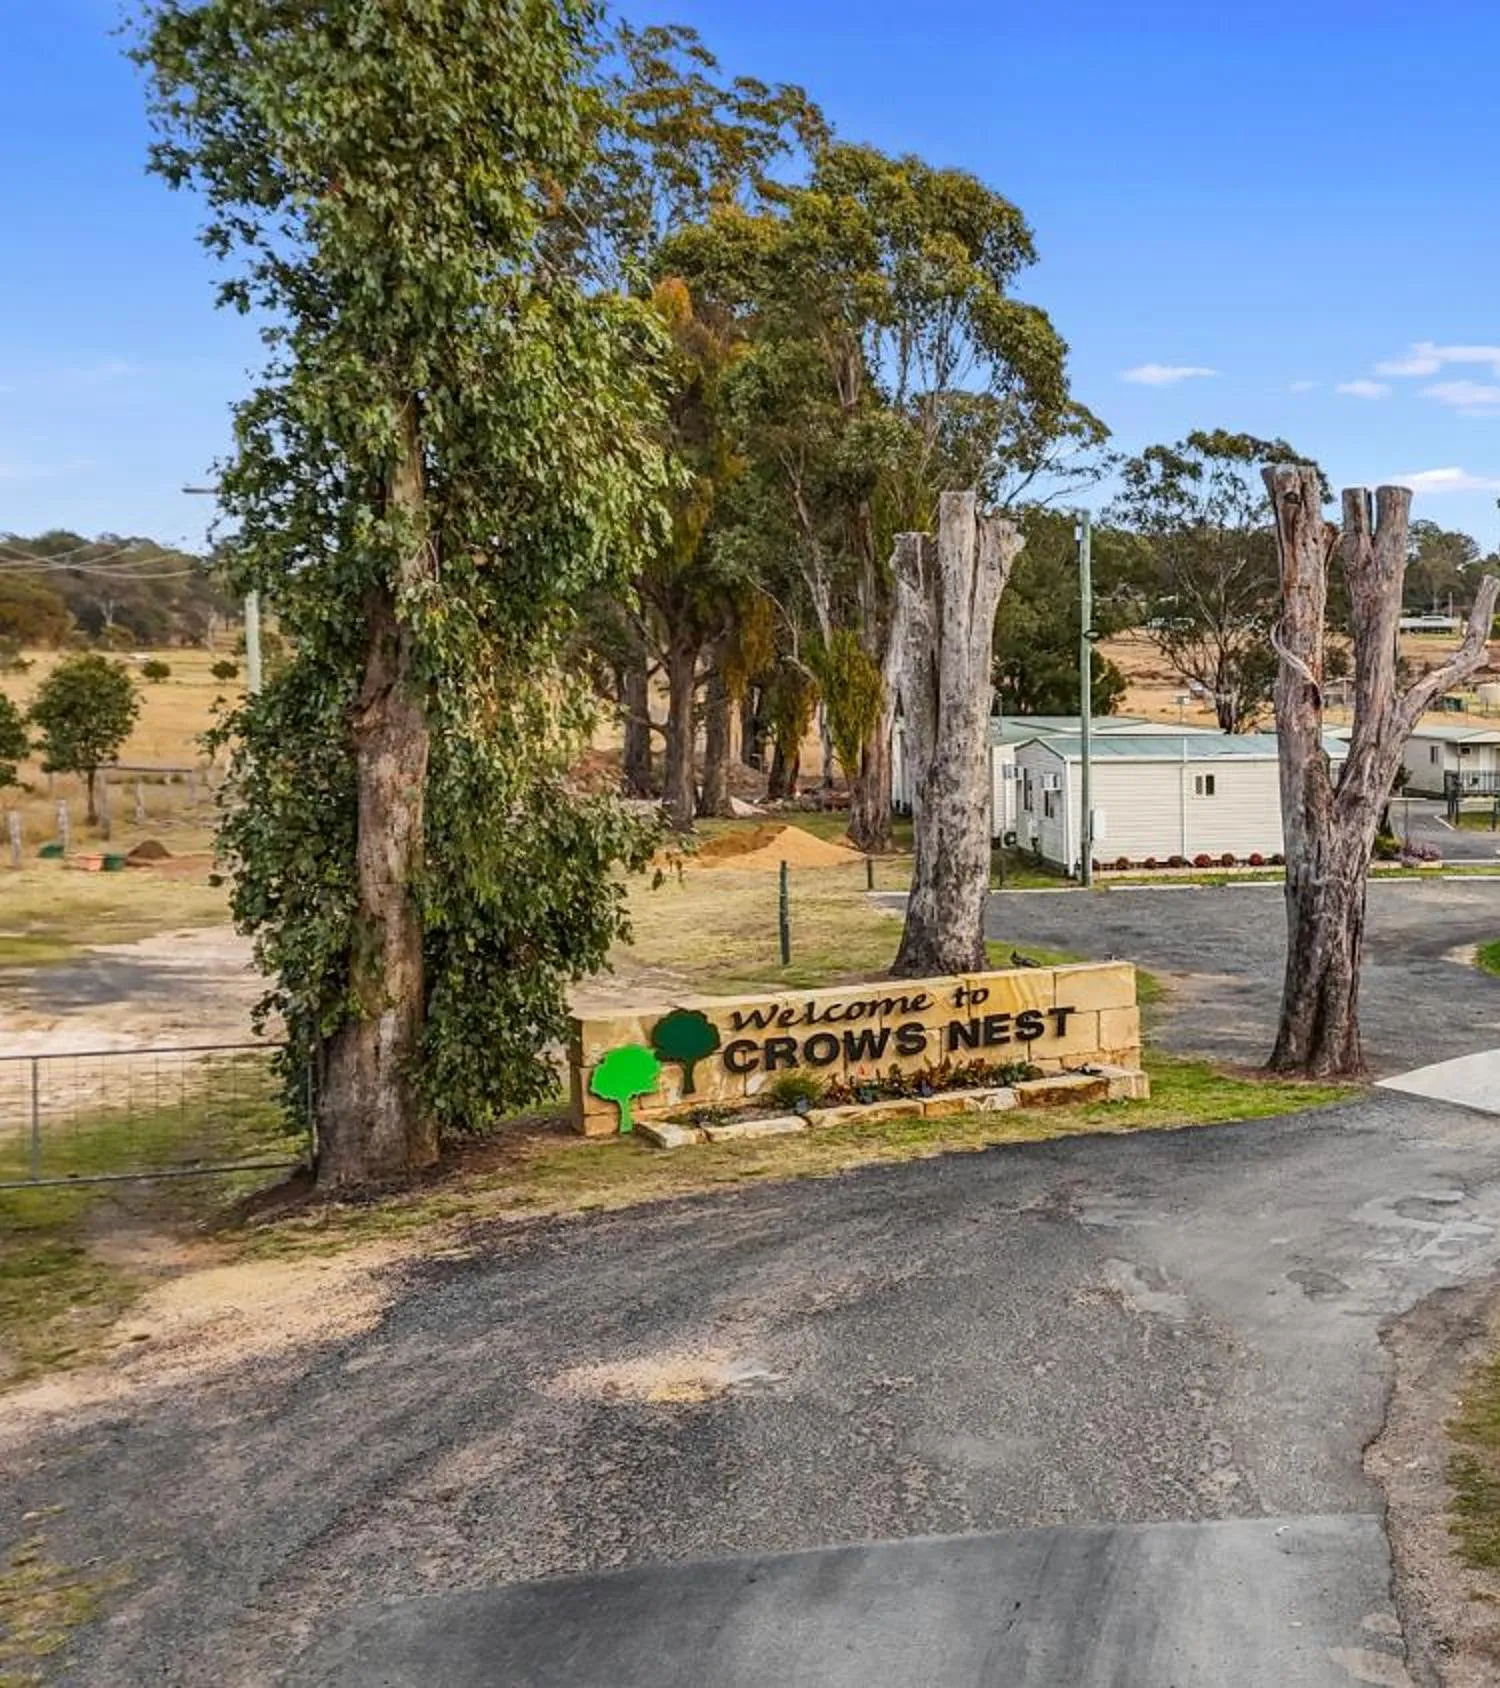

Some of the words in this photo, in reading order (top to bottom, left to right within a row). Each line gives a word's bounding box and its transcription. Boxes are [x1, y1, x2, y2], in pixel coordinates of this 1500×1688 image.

[731, 993, 934, 1031] Welcome
[952, 986, 989, 1008] to
[723, 1022, 928, 1074] CROWS
[947, 1006, 1075, 1052] NEST
